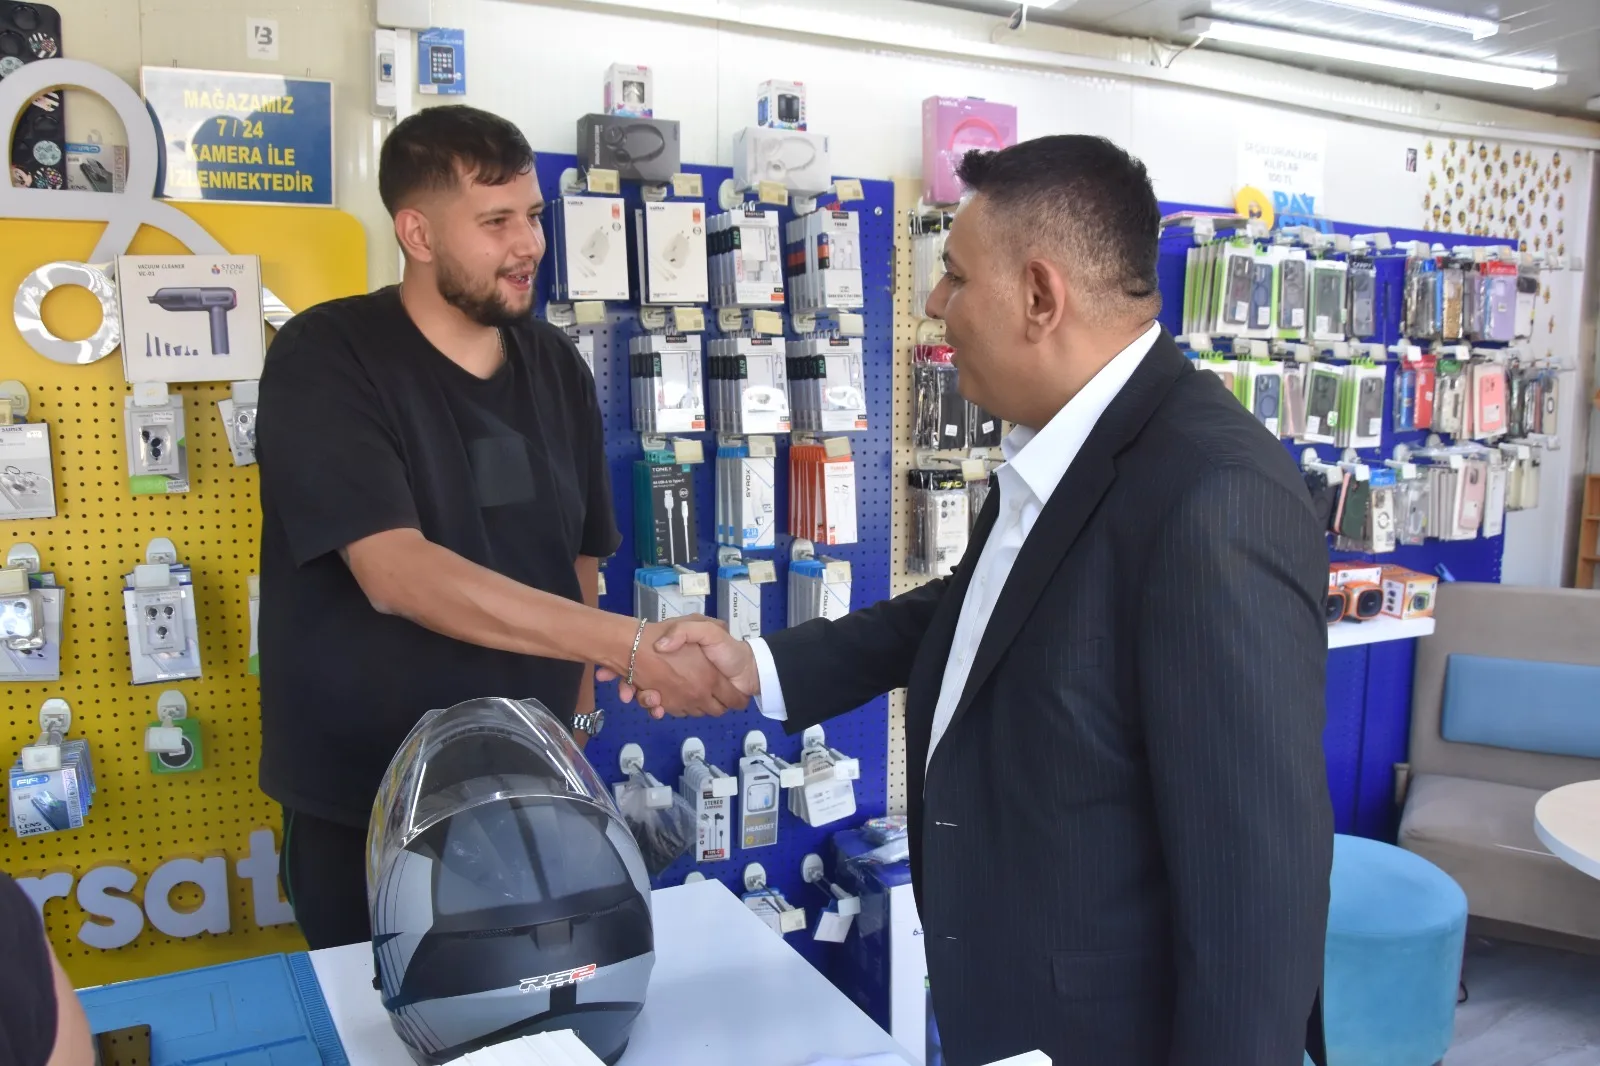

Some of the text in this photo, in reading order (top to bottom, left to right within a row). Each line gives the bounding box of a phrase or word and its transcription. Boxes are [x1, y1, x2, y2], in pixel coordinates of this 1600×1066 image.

[184, 88, 294, 114] MAĞAZAMIZ
[216, 119, 224, 138] 7
[242, 119, 264, 139] 24
[187, 145, 295, 166] KAMERA İLE
[168, 165, 314, 193] İZLENMEKTEDİR
[1273, 190, 1315, 215] PAY
[19, 821, 42, 829] LENS
[19, 825, 51, 836] SHIELD
[745, 822, 776, 833] HEADSET
